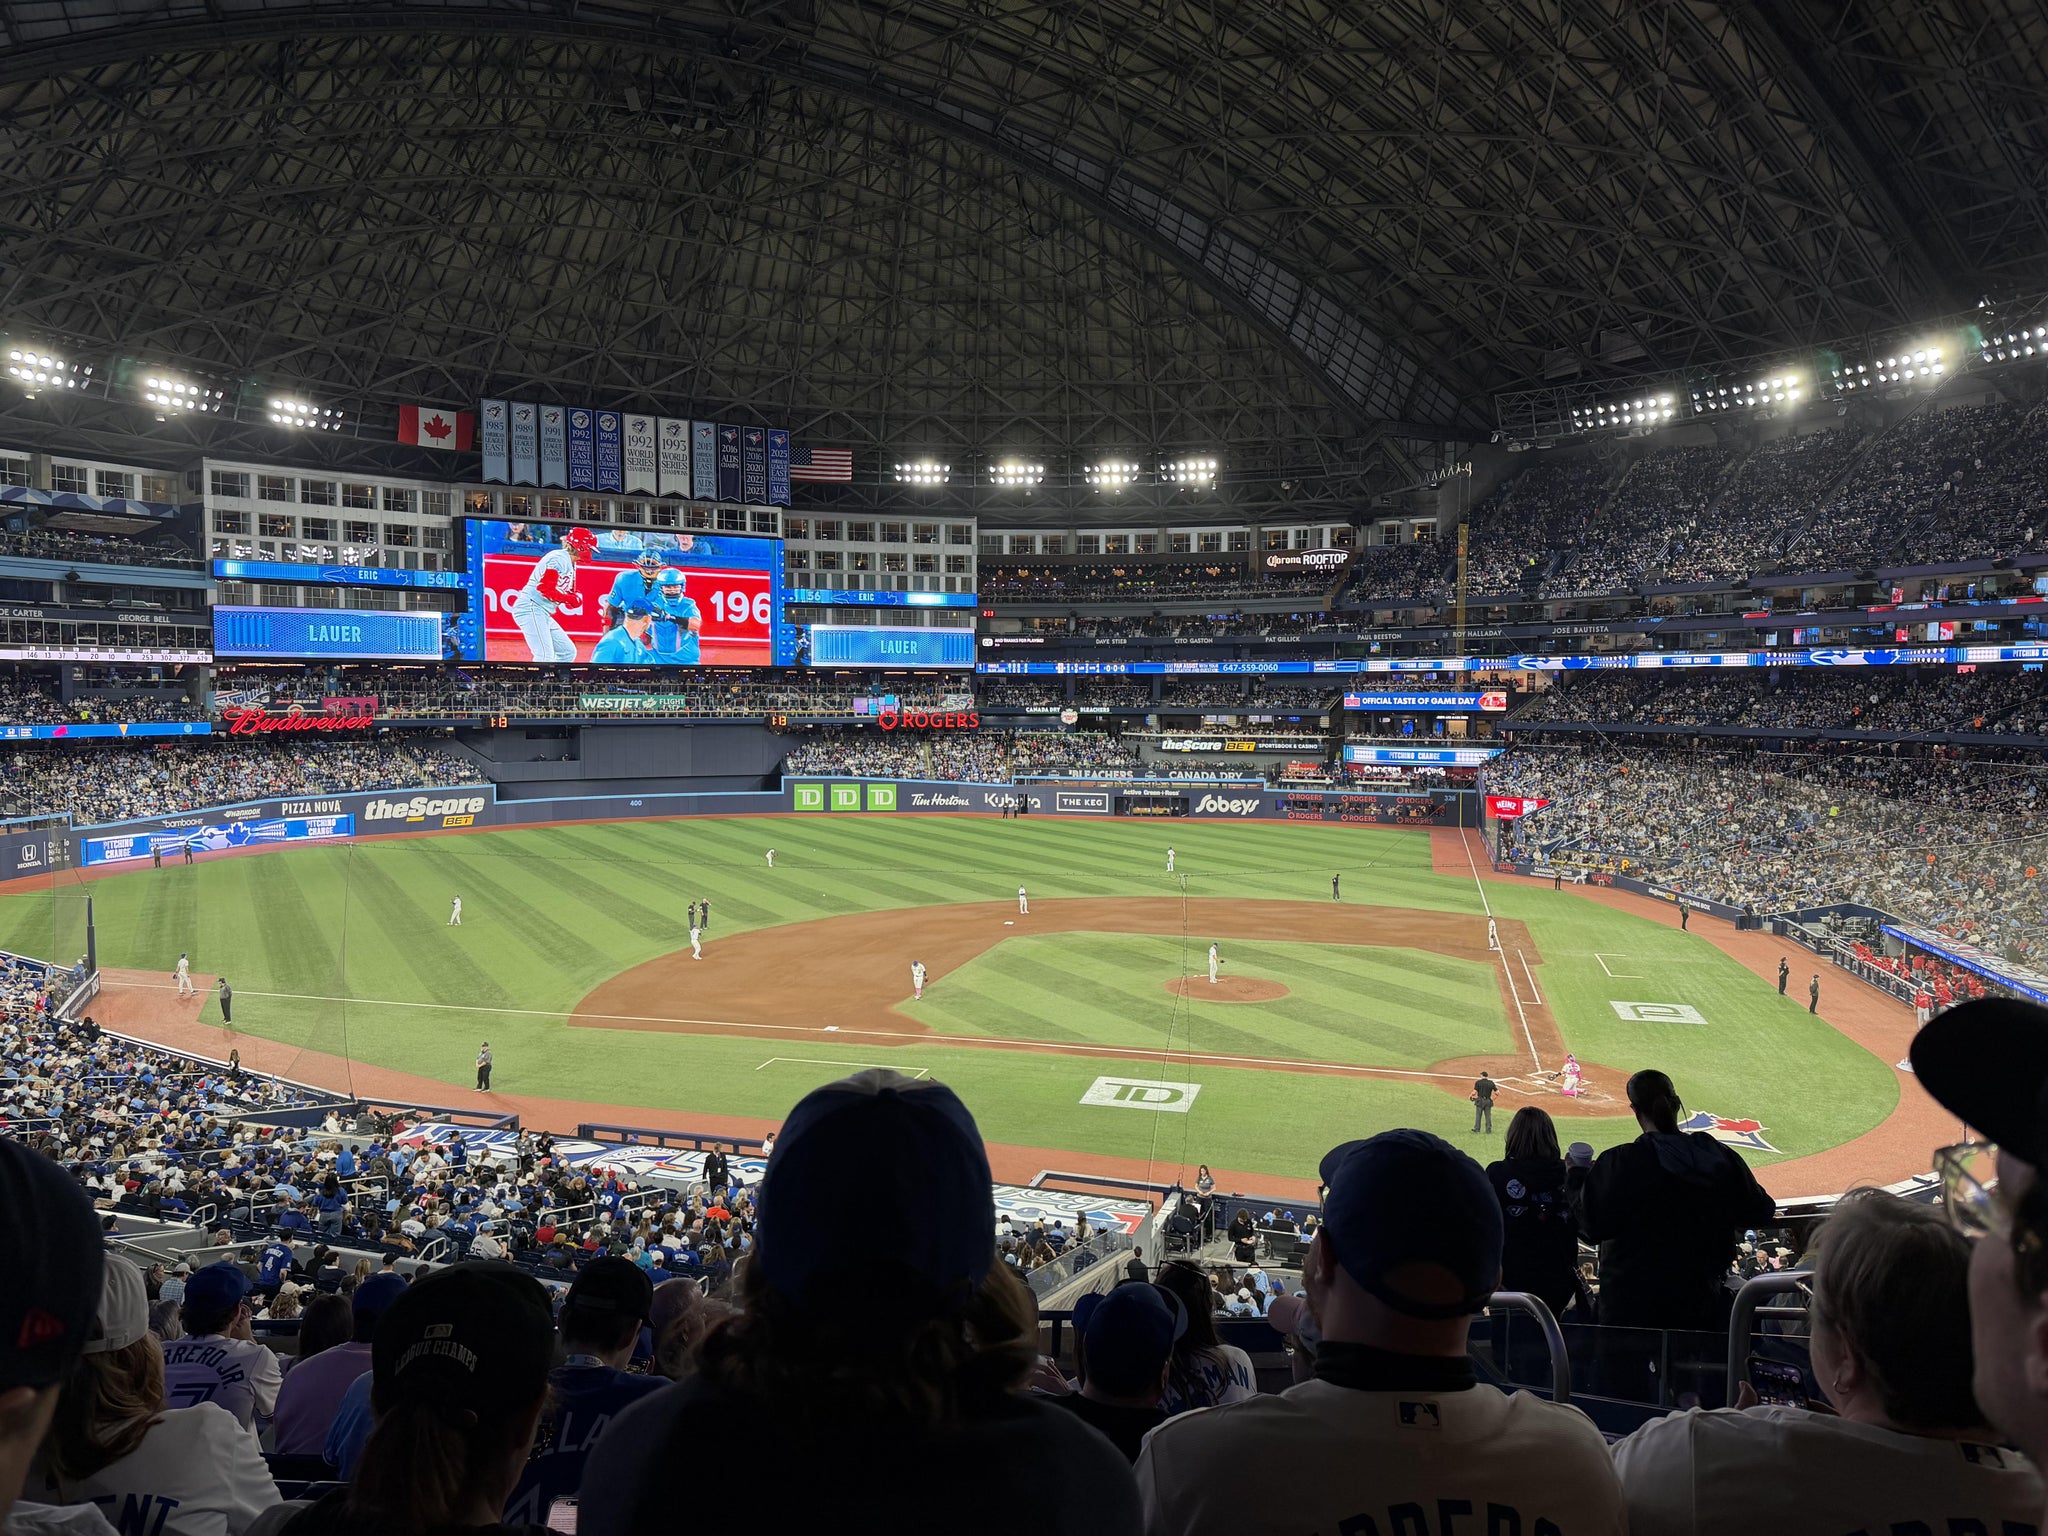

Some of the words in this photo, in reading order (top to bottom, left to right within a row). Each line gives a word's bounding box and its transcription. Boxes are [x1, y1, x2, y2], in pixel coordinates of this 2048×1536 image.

[486, 421, 504, 431] 1985
[515, 424, 533, 433] 1989
[544, 427, 561, 436] 1991
[572, 430, 590, 439] 1992
[600, 432, 618, 441] 1993
[628, 435, 652, 448] 1992
[662, 438, 686, 452] 1993
[696, 442, 712, 450] 2015
[485, 443, 505, 452] EAST
[514, 446, 534, 454] EAST
[722, 445, 738, 453] 2016
[485, 450, 506, 458] CHAMPS
[544, 449, 562, 457] EAST
[572, 451, 591, 459] EAST
[627, 448, 654, 458] WORLD
[662, 452, 688, 462] WORLD
[746, 452, 762, 460] 2016
[771, 449, 788, 458] 2025
[572, 458, 592, 466] CHAMPS
[600, 454, 618, 462] EAST
[627, 457, 654, 467] SERIES
[722, 455, 738, 463] ALDS
[600, 460, 619, 468] CHAMPS
[662, 461, 688, 470] SERIES
[696, 462, 712, 471] EAST
[746, 463, 763, 472] 2020
[572, 468, 592, 477] ALCS
[601, 470, 619, 480] ALCS
[600, 478, 620, 486] CHAMPS
[696, 479, 714, 487] ALDS
[746, 475, 763, 483] 2022
[747, 486, 764, 495] 2023
[1267, 555, 1302, 568] Corona
[1303, 554, 1348, 564] ROOFTOP
[358, 570, 378, 580] ERIC
[428, 574, 444, 585] 56
[806, 592, 820, 600] 56
[859, 592, 874, 601] ERIC
[1574, 590, 1610, 598] ROBINSON
[13, 609, 43, 618] CARTER
[118, 614, 150, 623] GEORGE
[154, 615, 170, 623] BELL
[309, 625, 362, 642] LAUER
[1552, 626, 1571, 634] JOSÉ
[880, 640, 918, 654] LAUER
[2013, 649, 2039, 658] PITCHING
[582, 698, 641, 710] WESTJET
[1362, 697, 1392, 705] OFFICIAL
[1393, 697, 1416, 705] TASTE
[1417, 697, 1429, 705] OF
[1431, 697, 1456, 705] GAME
[1458, 697, 1475, 705] DAY
[224, 709, 374, 735] Budweiser
[903, 712, 979, 728] ROGERS
[1162, 740, 1221, 750] theScore
[1389, 752, 1414, 760] PITCHING
[1418, 752, 1440, 760] CHANGE
[1372, 766, 1401, 774] ROGERS
[1169, 771, 1211, 779] CANADA
[1214, 772, 1242, 780] DRY
[798, 790, 820, 805] TD
[834, 790, 857, 805] TD
[871, 790, 893, 805] TD
[912, 793, 929, 806] Tim
[930, 793, 969, 806] Hortons
[282, 802, 311, 816] PIZZA
[314, 800, 340, 814] NOVA
[364, 797, 485, 820] theScore
[1195, 794, 1260, 815] Sobeys
[1496, 801, 1516, 810] HEINZ
[306, 818, 336, 829] PITCHING
[446, 816, 471, 825] BET
[308, 827, 334, 836] CHANGE
[103, 838, 134, 850] PITCHING
[106, 849, 131, 859] CHANGE
[17, 860, 42, 869] HONDA
[1498, 863, 1517, 872] HEINZ
[1105, 1082, 1184, 1104] TD
[600, 1194, 613, 1205] 29
[265, 1256, 273, 1271] 4
[433, 1340, 480, 1373] CHAMPS
[216, 1363, 244, 1390] JR.
